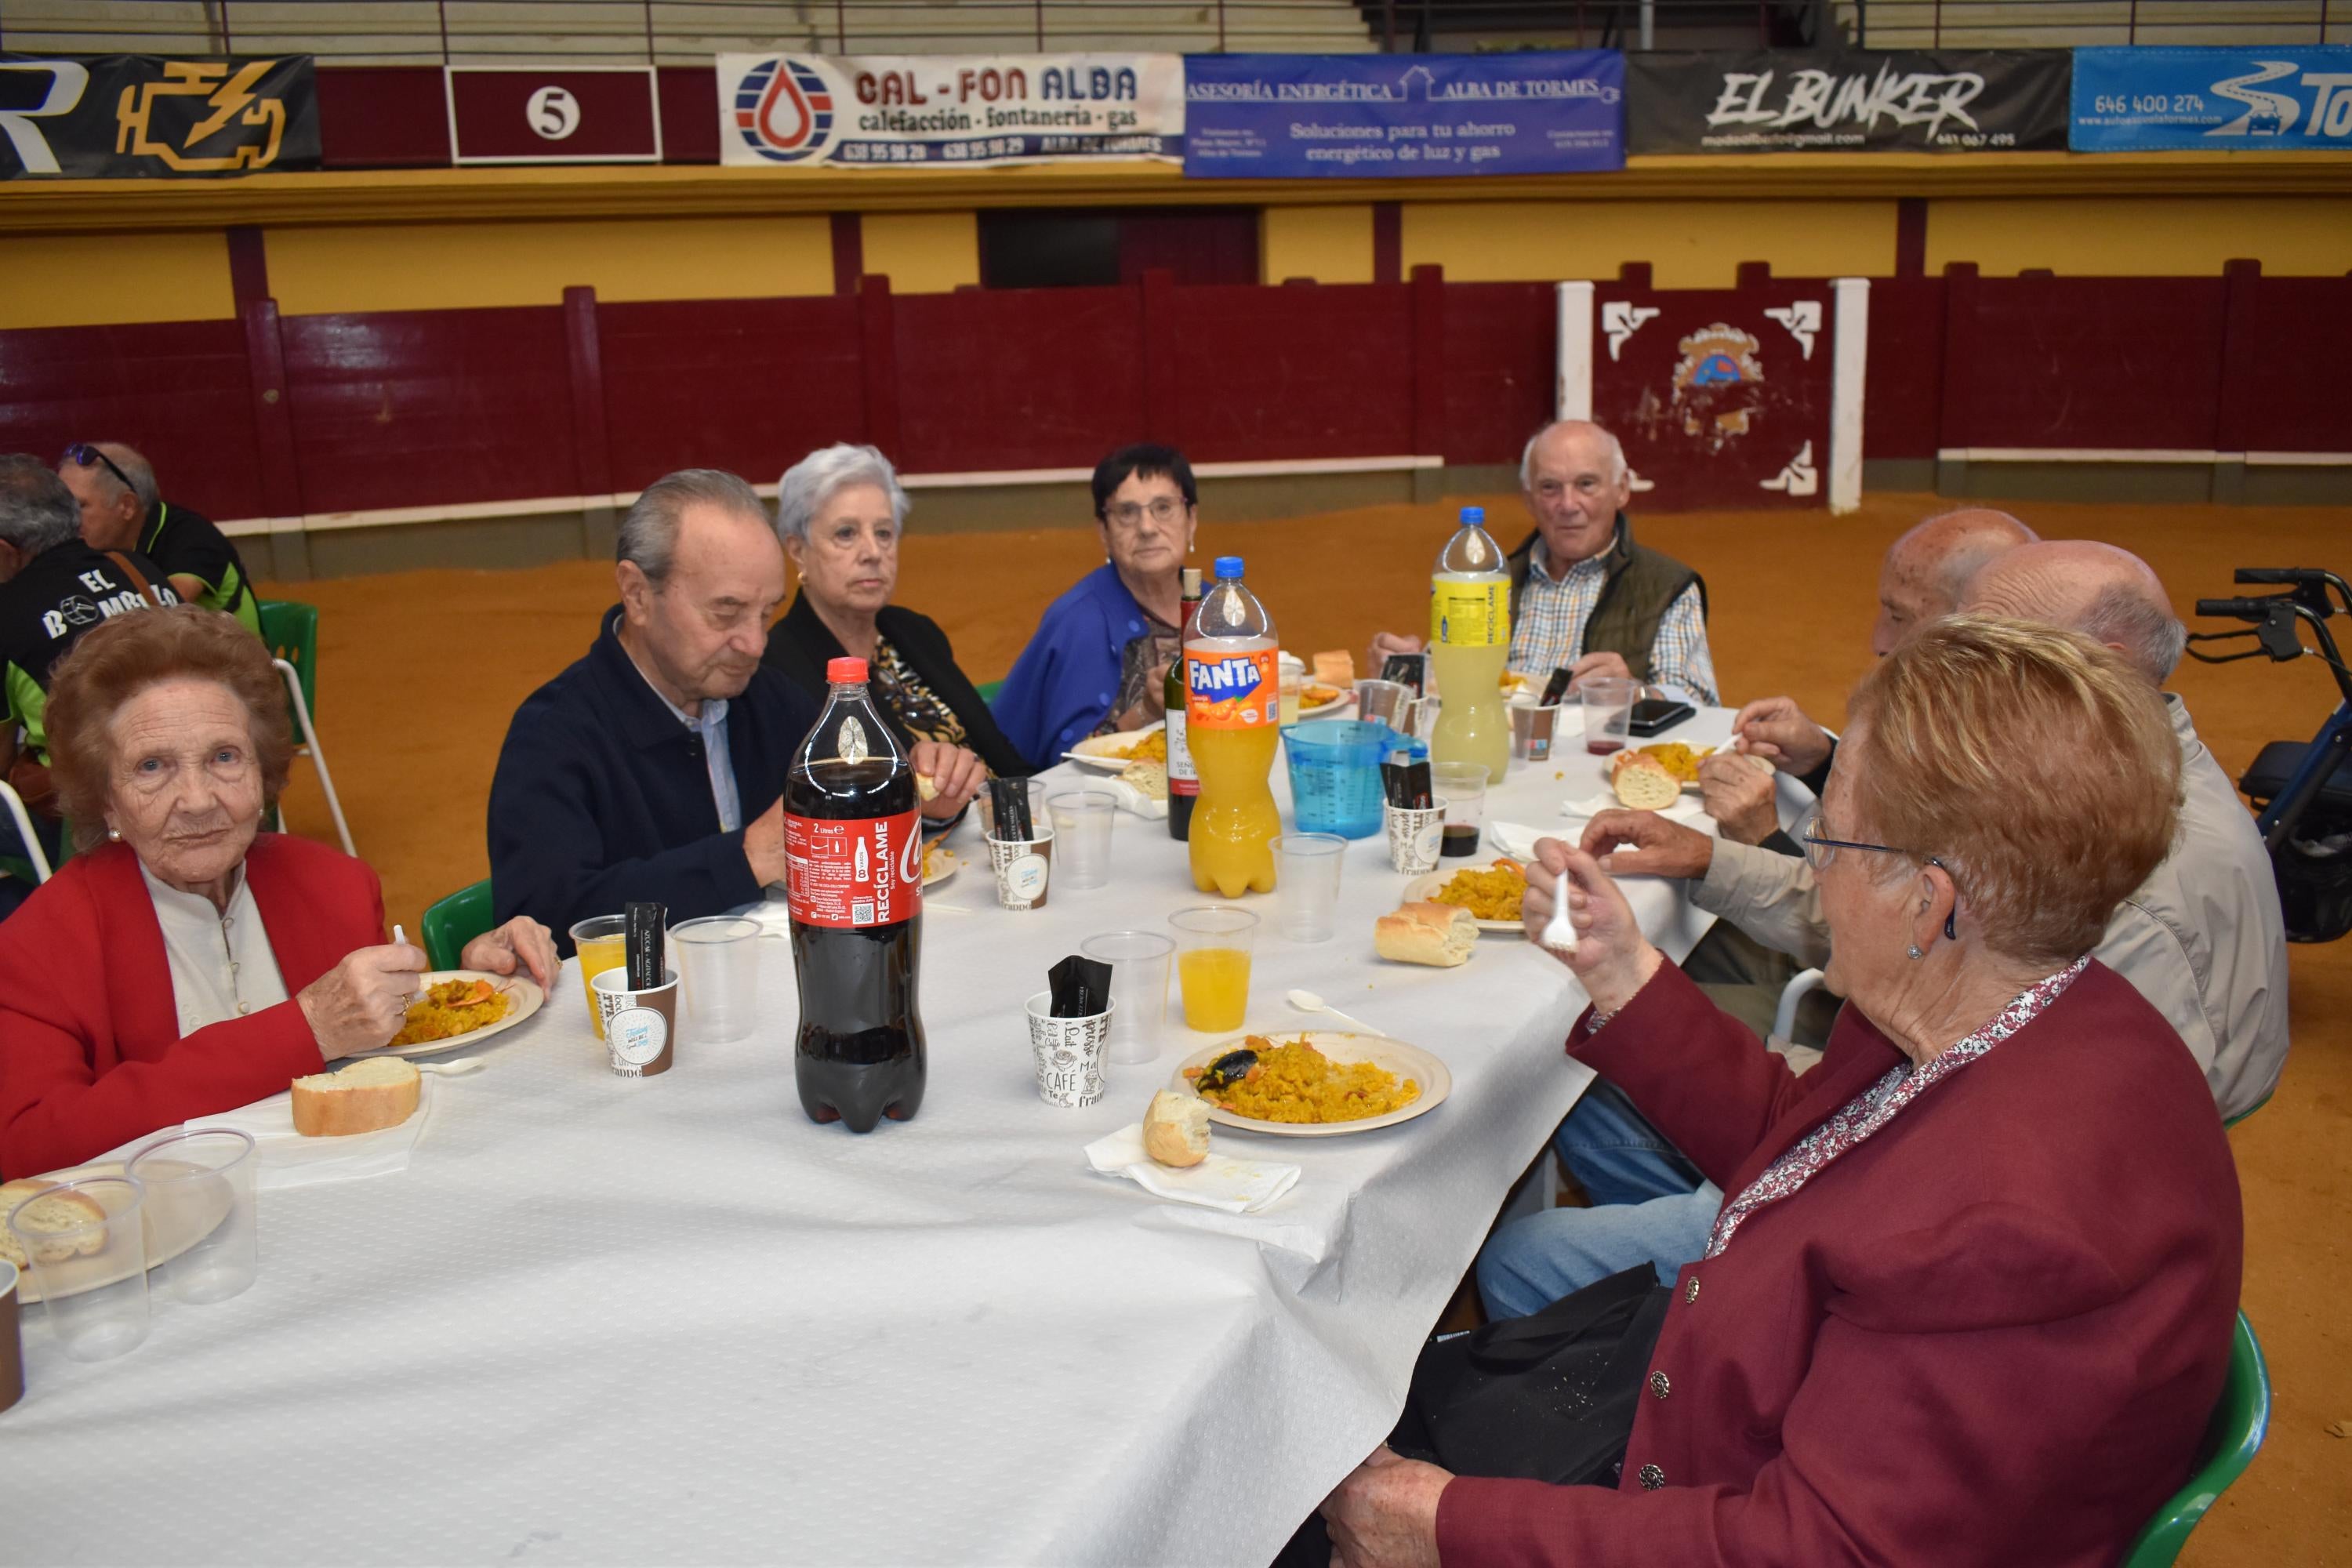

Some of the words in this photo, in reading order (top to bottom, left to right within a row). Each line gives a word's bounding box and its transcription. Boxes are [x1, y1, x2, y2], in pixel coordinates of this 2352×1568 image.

[856, 71, 927, 105] CAL
[959, 68, 1027, 103] FON
[1042, 67, 1137, 100] ALBA
[1187, 79, 1274, 100] ASESORÍA
[1278, 79, 1393, 100] ENERGÉTICA
[1444, 82, 1492, 98] ALBA
[1496, 81, 1519, 97] DE
[1526, 78, 1599, 96] TORMES
[1705, 69, 1781, 129] EL
[1766, 57, 1984, 143] BUNKER
[2095, 95, 2126, 113] 646
[2132, 95, 2167, 113] 400
[2173, 94, 2204, 113] 274
[541, 92, 567, 136] 5
[859, 108, 971, 131] calefacción
[1107, 110, 1138, 132] gas
[1290, 122, 1384, 139] Soluciones
[1388, 125, 1427, 142] para
[1432, 124, 1452, 137] tu
[1456, 121, 1515, 137] ahorro
[1305, 144, 1394, 165] energético
[1397, 144, 1419, 161] de
[1423, 143, 1450, 160] luz
[1453, 147, 1466, 163] y
[1469, 146, 1501, 163] gas
[78, 569, 117, 593] EL
[1189, 658, 1261, 690] FANTA
[814, 823, 818, 833] 2
[858, 869, 866, 879] 8
[873, 821, 890, 923] RECÍCLAME
[1046, 1069, 1077, 1091] CAFÉ
